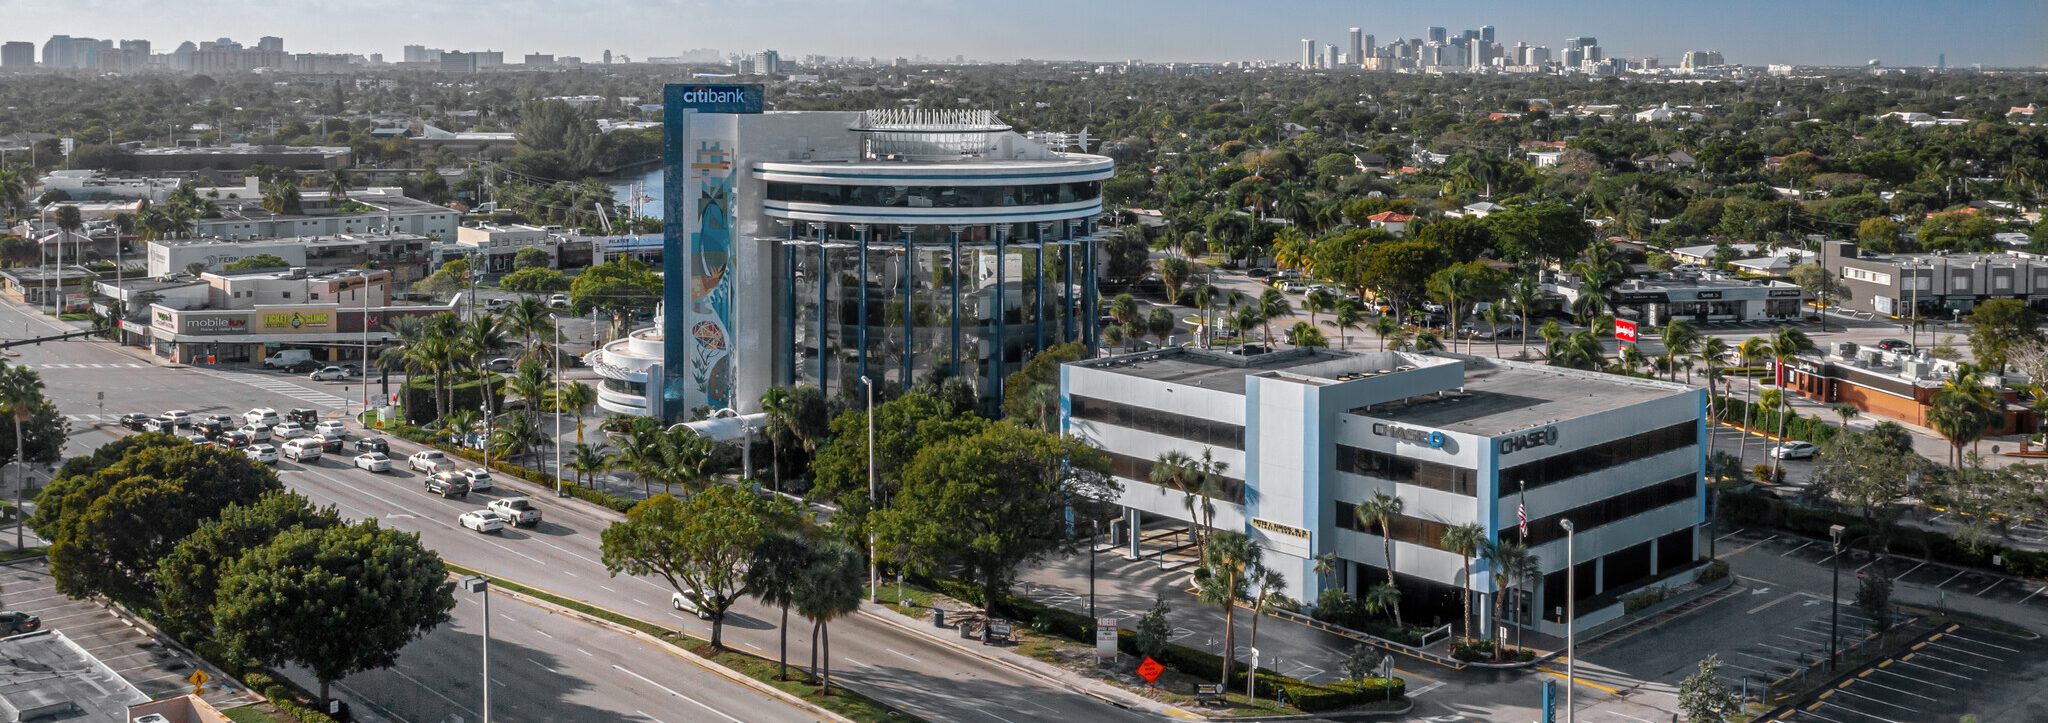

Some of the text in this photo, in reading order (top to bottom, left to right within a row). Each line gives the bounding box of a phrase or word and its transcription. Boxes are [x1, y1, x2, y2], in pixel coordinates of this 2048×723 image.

[683, 88, 745, 103] citibank
[1373, 422, 1429, 442] CHASE
[1499, 431, 1545, 455] CHASE
